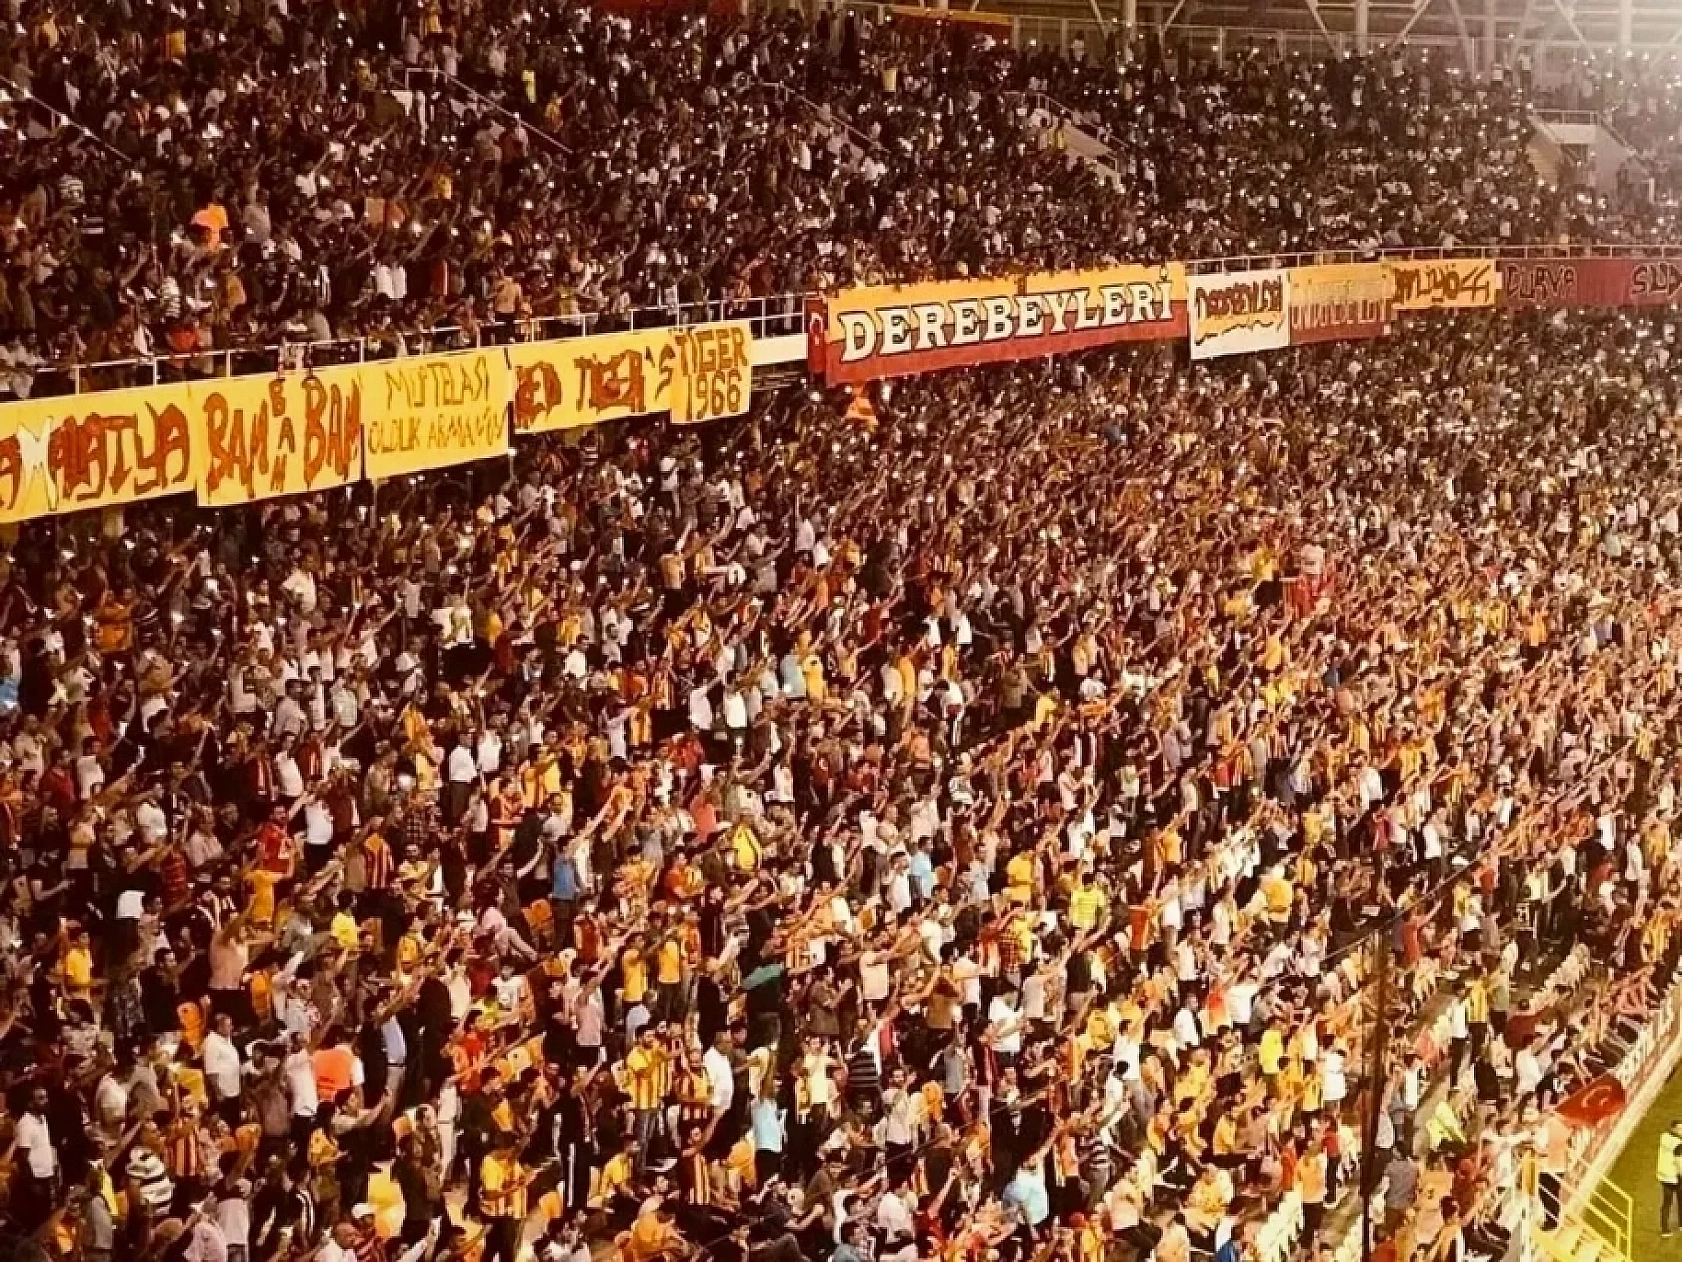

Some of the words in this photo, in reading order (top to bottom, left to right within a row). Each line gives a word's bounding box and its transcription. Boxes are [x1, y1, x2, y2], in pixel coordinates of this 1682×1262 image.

[838, 267, 1173, 363] DEREBEYLERİ
[675, 327, 748, 377] TIGER
[686, 369, 742, 421] 1966
